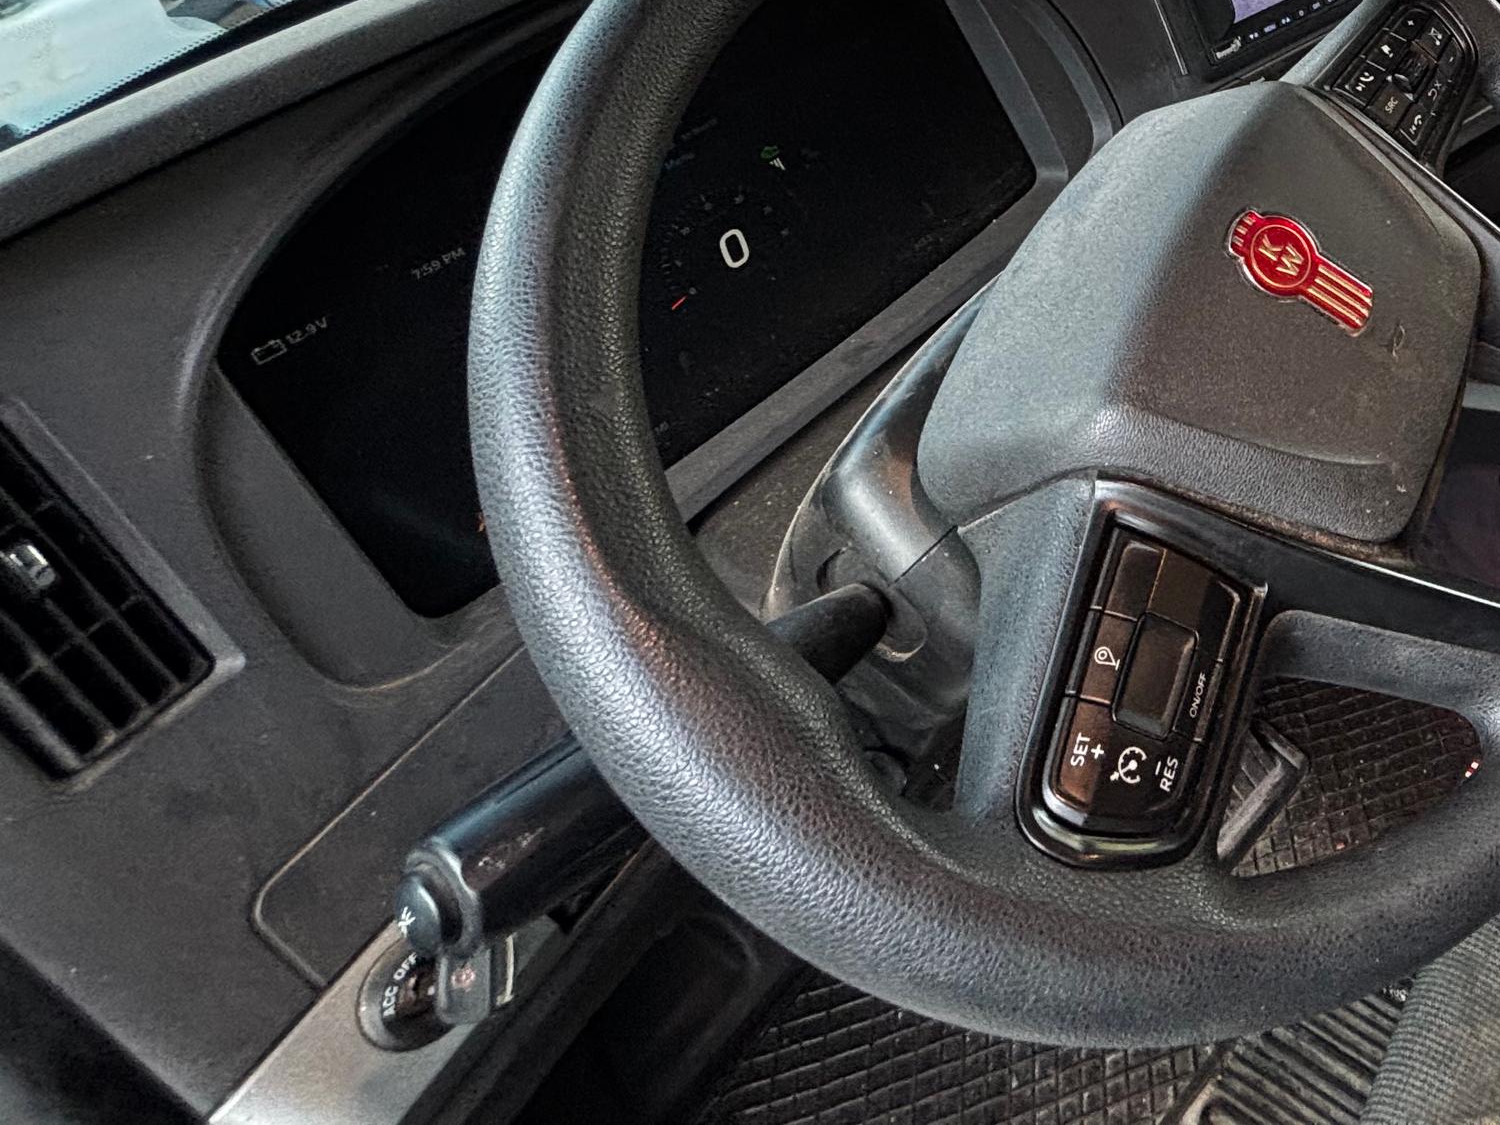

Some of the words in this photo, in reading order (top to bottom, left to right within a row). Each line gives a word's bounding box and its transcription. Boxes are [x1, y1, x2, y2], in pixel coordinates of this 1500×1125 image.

[1384, 96, 1399, 114] SRC
[718, 227, 751, 269] 0
[1189, 672, 1207, 719] ON/OFF
[1070, 732, 1091, 767] SET
[1160, 756, 1180, 792] RES
[393, 952, 418, 981] OFF
[382, 986, 399, 1017] ACC
